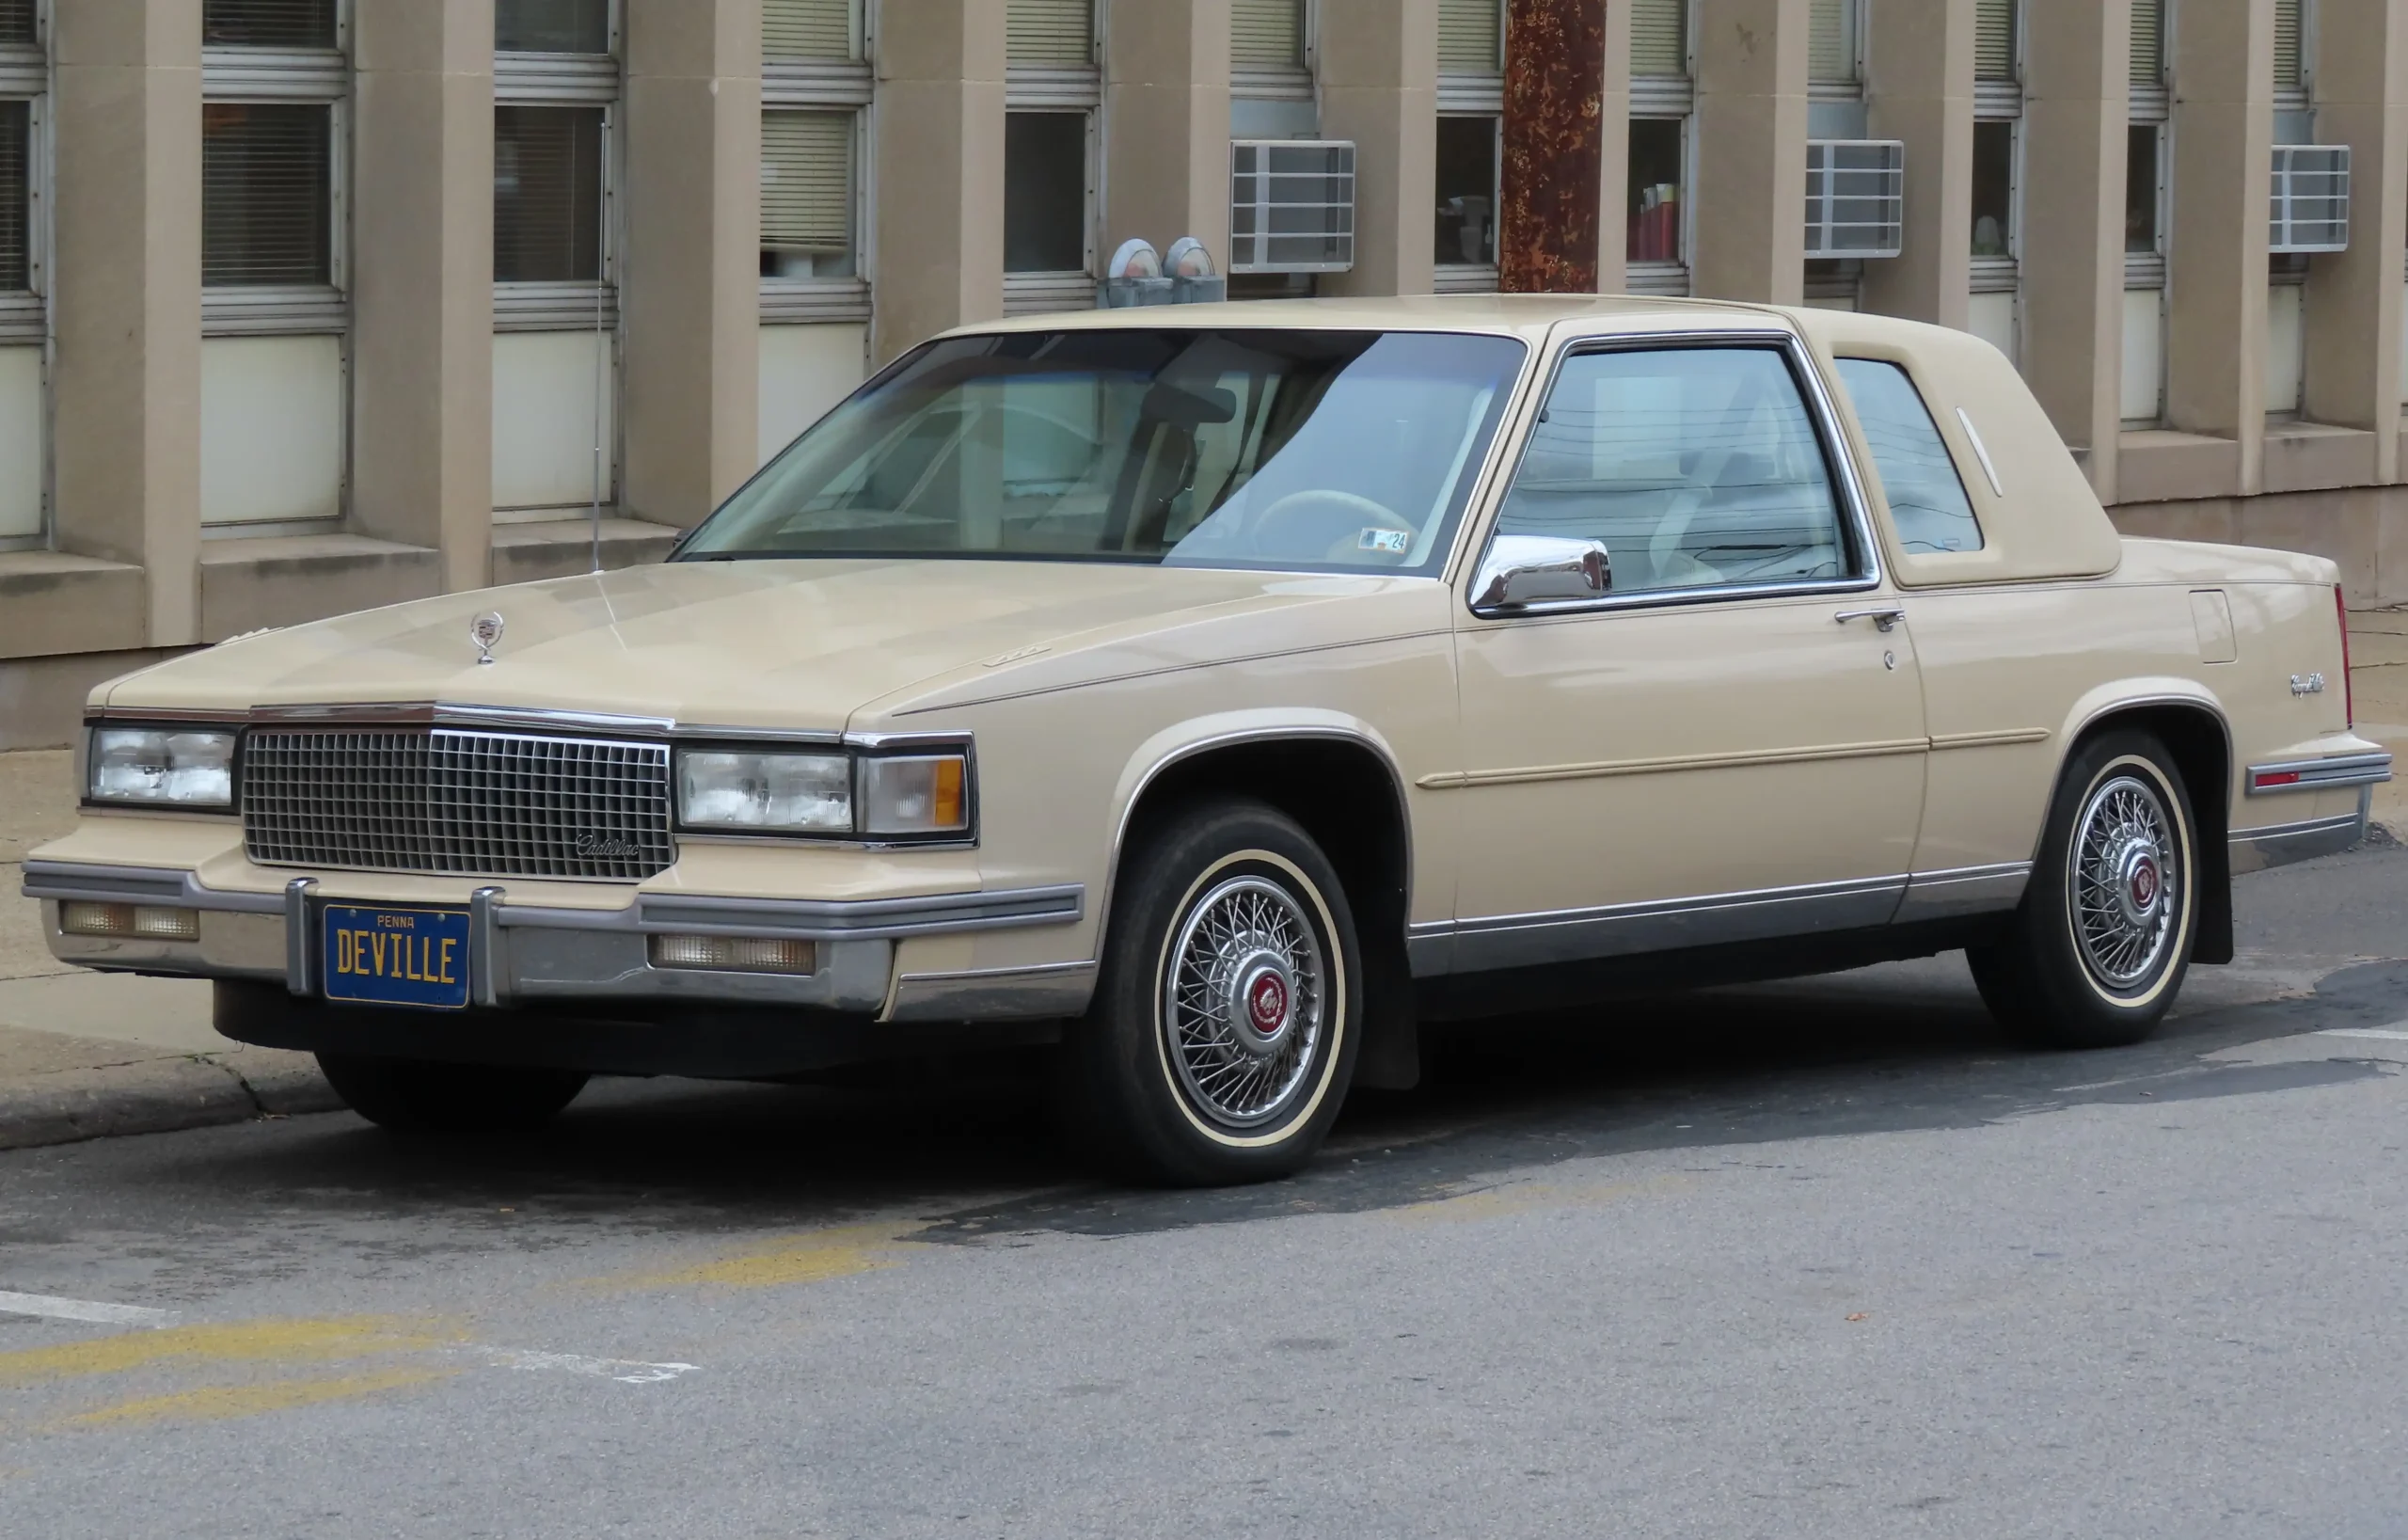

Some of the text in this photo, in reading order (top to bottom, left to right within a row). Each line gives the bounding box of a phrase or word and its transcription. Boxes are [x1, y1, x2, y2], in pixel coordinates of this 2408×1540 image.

[576, 834, 639, 856] Cadillac
[377, 915, 415, 929] PENNA
[337, 929, 457, 984] DEVILLE
